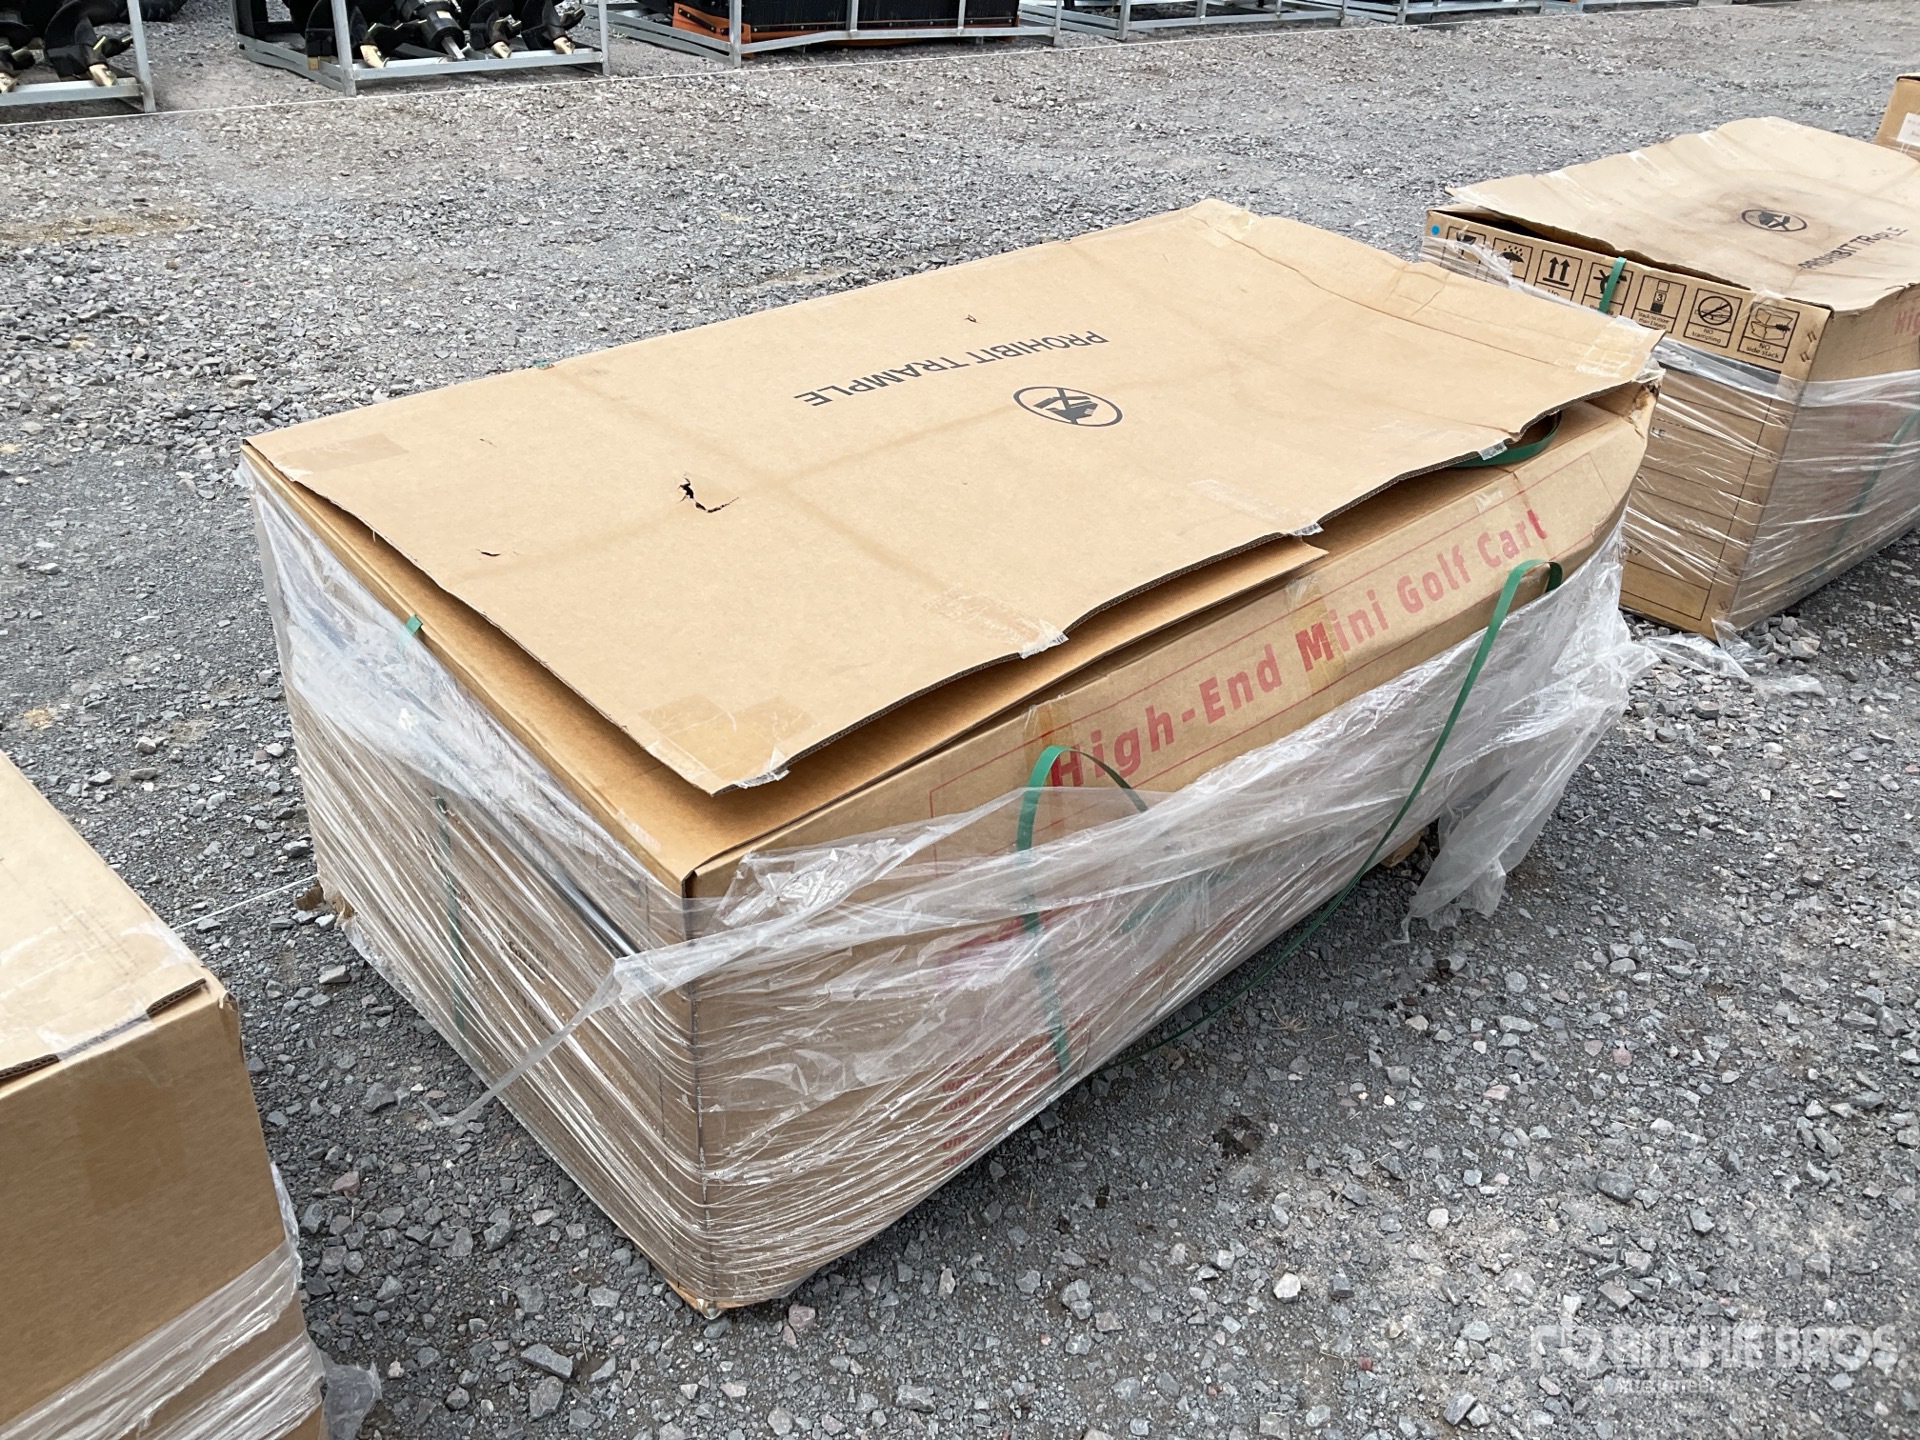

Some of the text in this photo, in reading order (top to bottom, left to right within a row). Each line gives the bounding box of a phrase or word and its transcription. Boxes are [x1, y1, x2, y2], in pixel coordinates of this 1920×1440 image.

[1691, 330, 1722, 343] trampling
[1746, 345, 1780, 358] side stack
[1759, 342, 1771, 350] NO
[793, 330, 1110, 407] PROHIBIT TRAMPLE
[1051, 508, 1549, 790] High-End Mini Golf Cart
